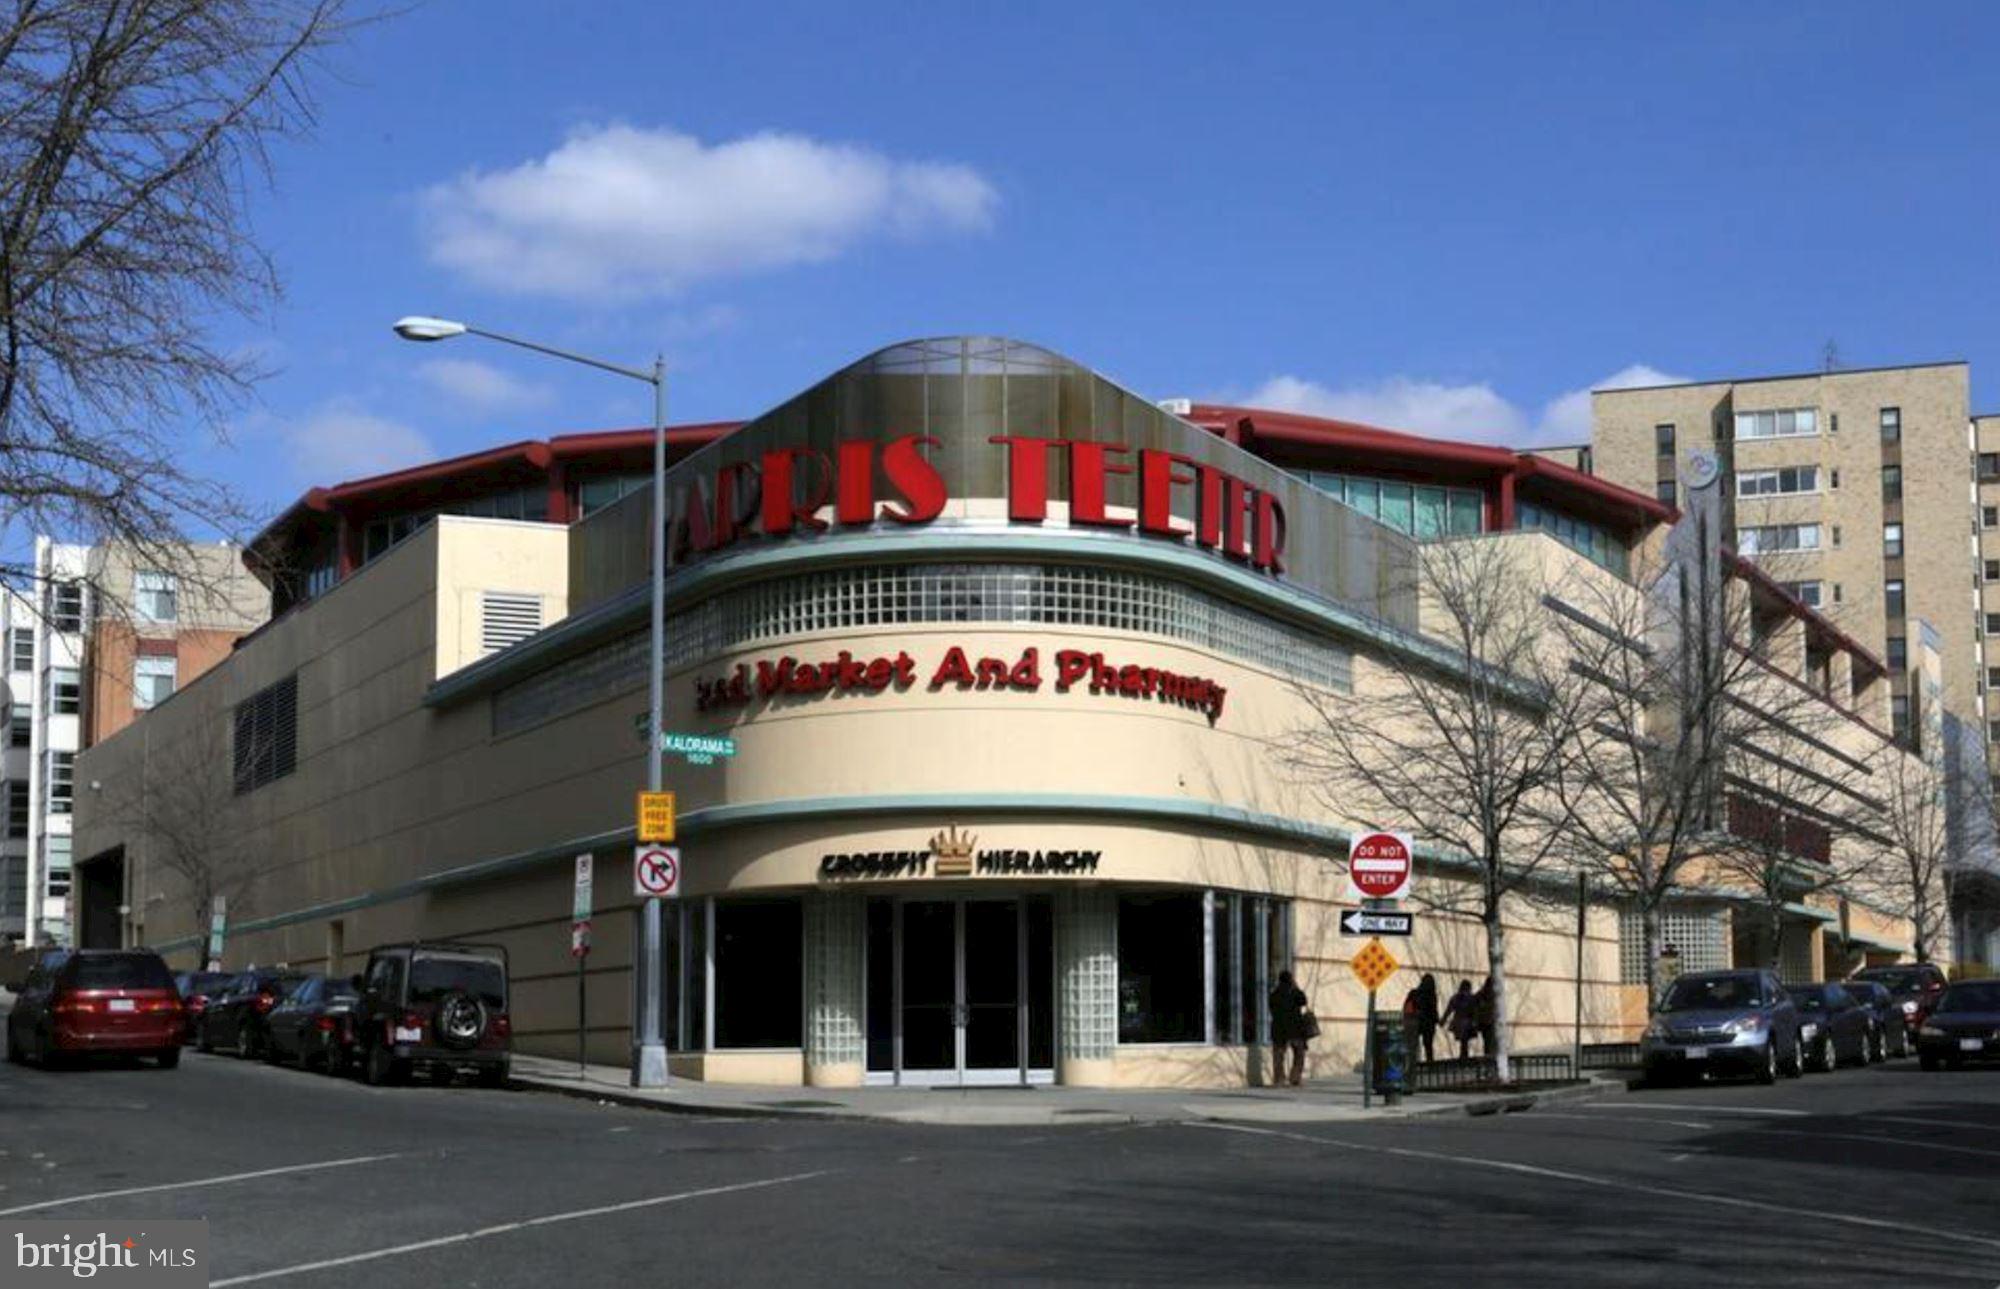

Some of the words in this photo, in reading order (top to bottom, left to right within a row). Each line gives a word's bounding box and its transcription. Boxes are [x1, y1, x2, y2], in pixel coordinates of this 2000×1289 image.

[758, 651, 916, 697] Market
[930, 647, 1041, 691] And
[1360, 846, 1375, 856] DO
[1380, 847, 1402, 857] NOT
[976, 850, 1101, 876] HIERARCHY
[1361, 874, 1396, 885] ENTER
[1362, 917, 1380, 929] ONE
[1384, 918, 1404, 929] WAY
